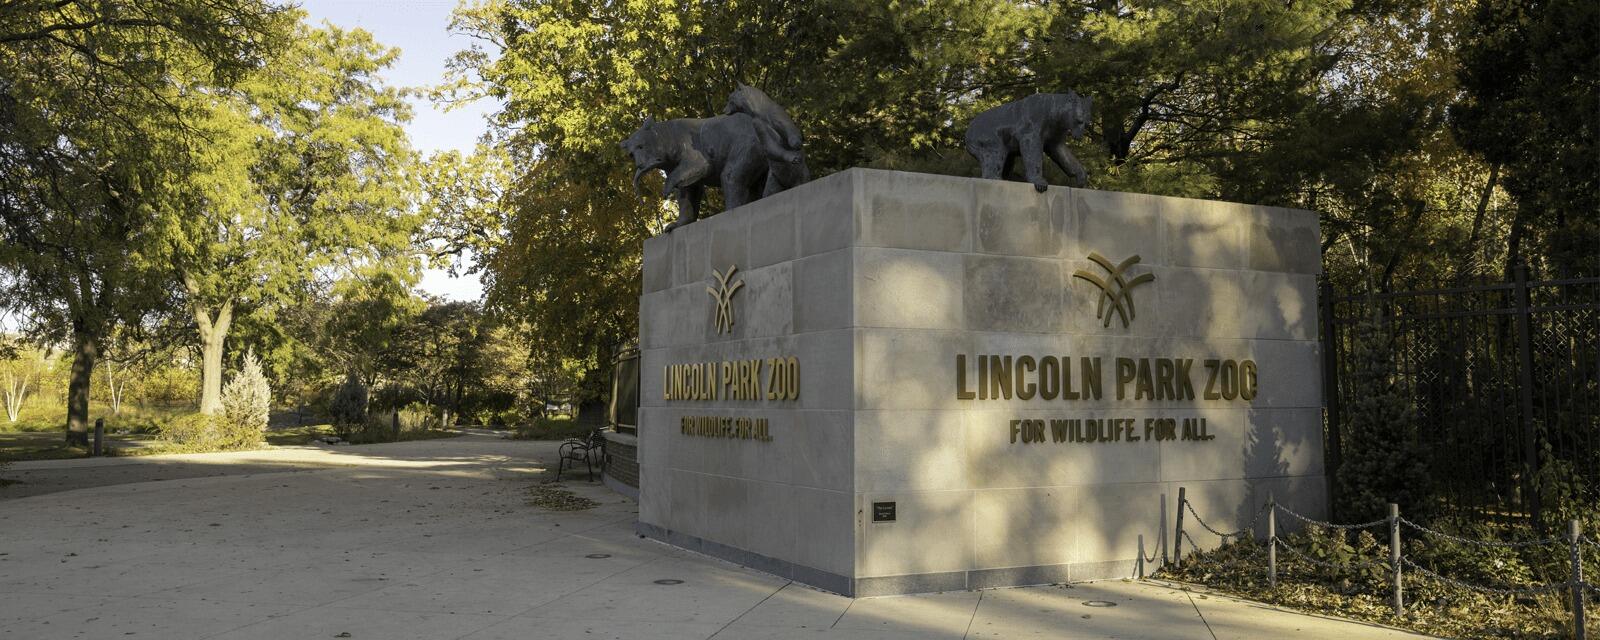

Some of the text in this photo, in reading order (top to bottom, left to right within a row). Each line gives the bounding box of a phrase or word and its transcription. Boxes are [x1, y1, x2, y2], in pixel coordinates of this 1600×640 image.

[663, 355, 800, 401] LINCOLN PARK ZOO
[956, 354, 1258, 401] LINCOLN PARK ZOO
[681, 415, 774, 442] FOR WILDLIFE. FOR ALL.
[1009, 417, 1216, 444] FOR WILDLIFE. FOR ALL.
